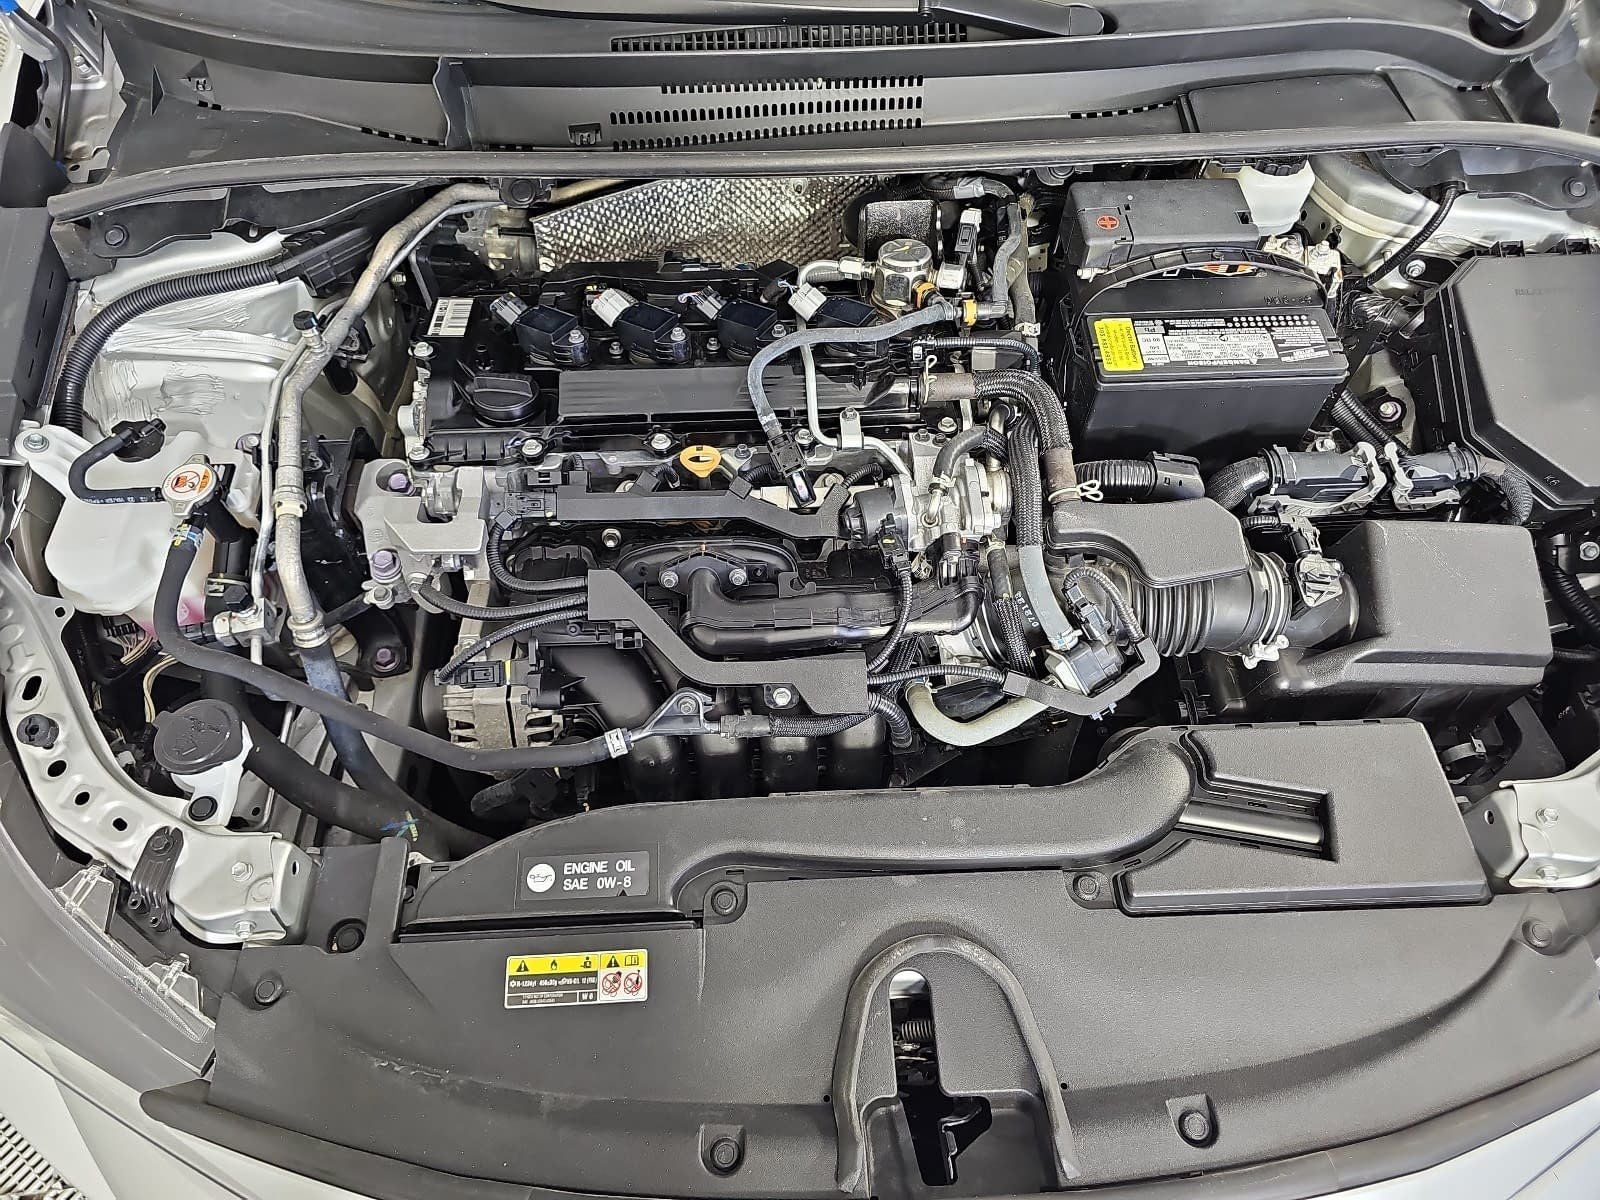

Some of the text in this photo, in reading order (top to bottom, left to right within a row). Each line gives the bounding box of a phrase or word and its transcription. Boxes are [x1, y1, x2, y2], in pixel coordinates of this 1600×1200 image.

[563, 859, 636, 875] ENGINE OIL
[562, 875, 632, 891] SAE 0W-8
